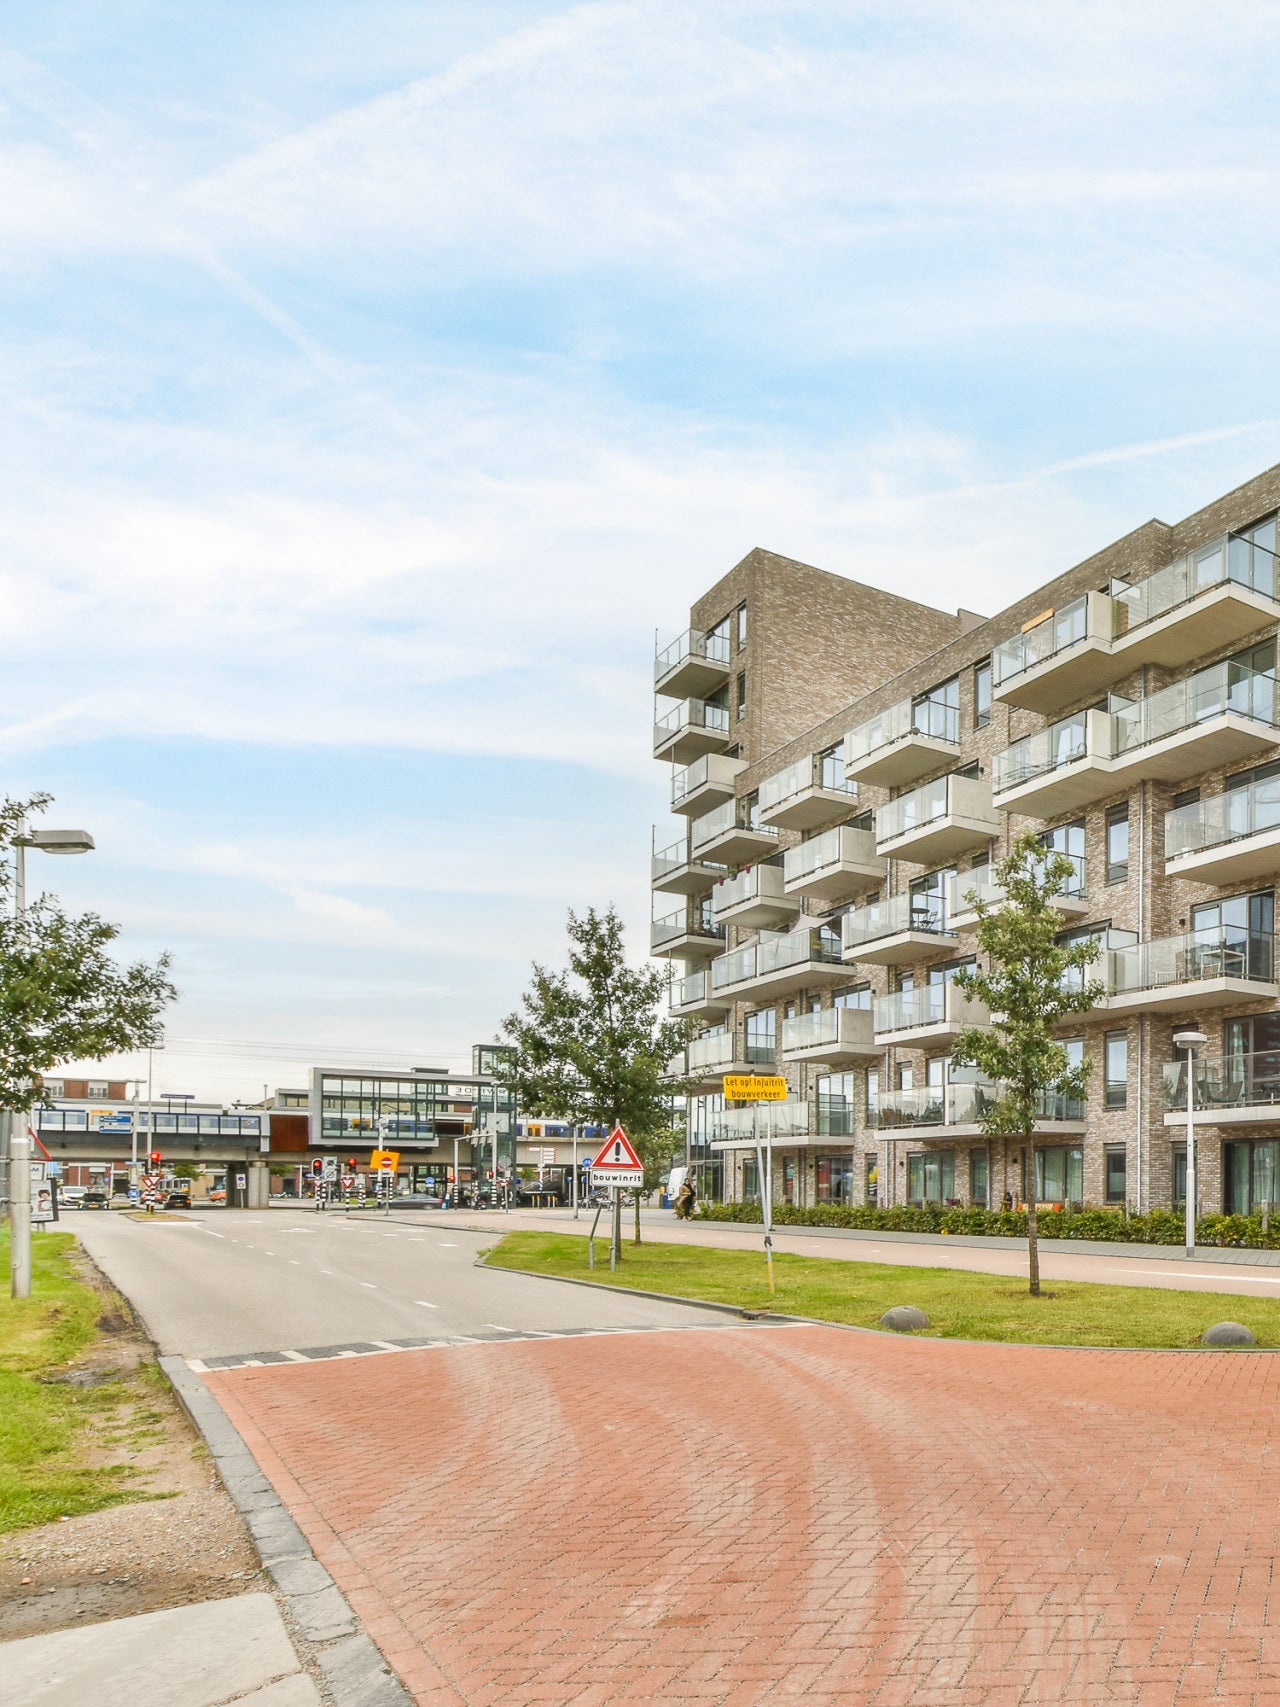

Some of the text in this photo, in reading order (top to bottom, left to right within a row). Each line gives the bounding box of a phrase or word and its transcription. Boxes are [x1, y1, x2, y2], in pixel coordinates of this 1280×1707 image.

[726, 1077, 738, 1086] Let
[740, 1078, 752, 1087] op!
[732, 1090, 780, 1098] bouwverkeer
